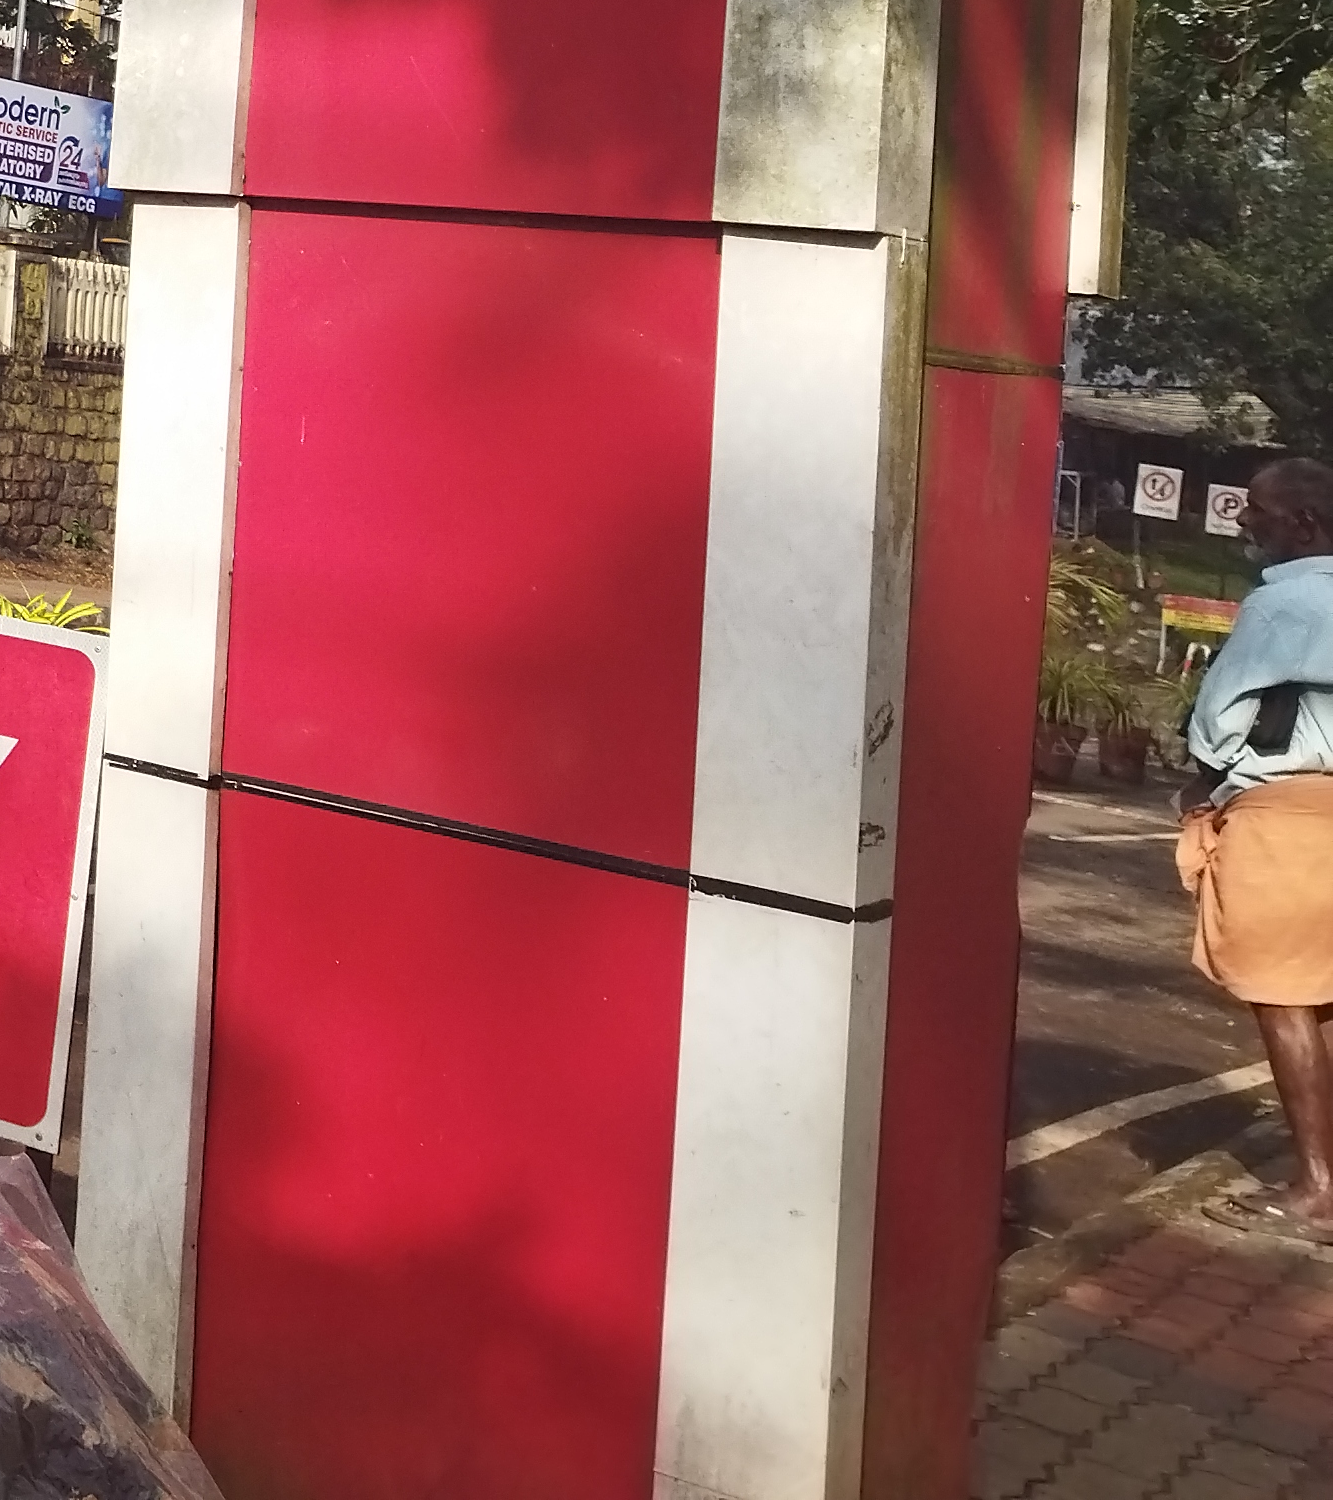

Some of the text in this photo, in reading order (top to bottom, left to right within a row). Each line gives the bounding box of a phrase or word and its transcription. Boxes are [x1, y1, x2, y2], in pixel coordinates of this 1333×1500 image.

[16, 125, 59, 144] SERVICE
[59, 143, 84, 171] 24
[22, 186, 63, 207] X-RAY
[68, 195, 96, 213] ECG
